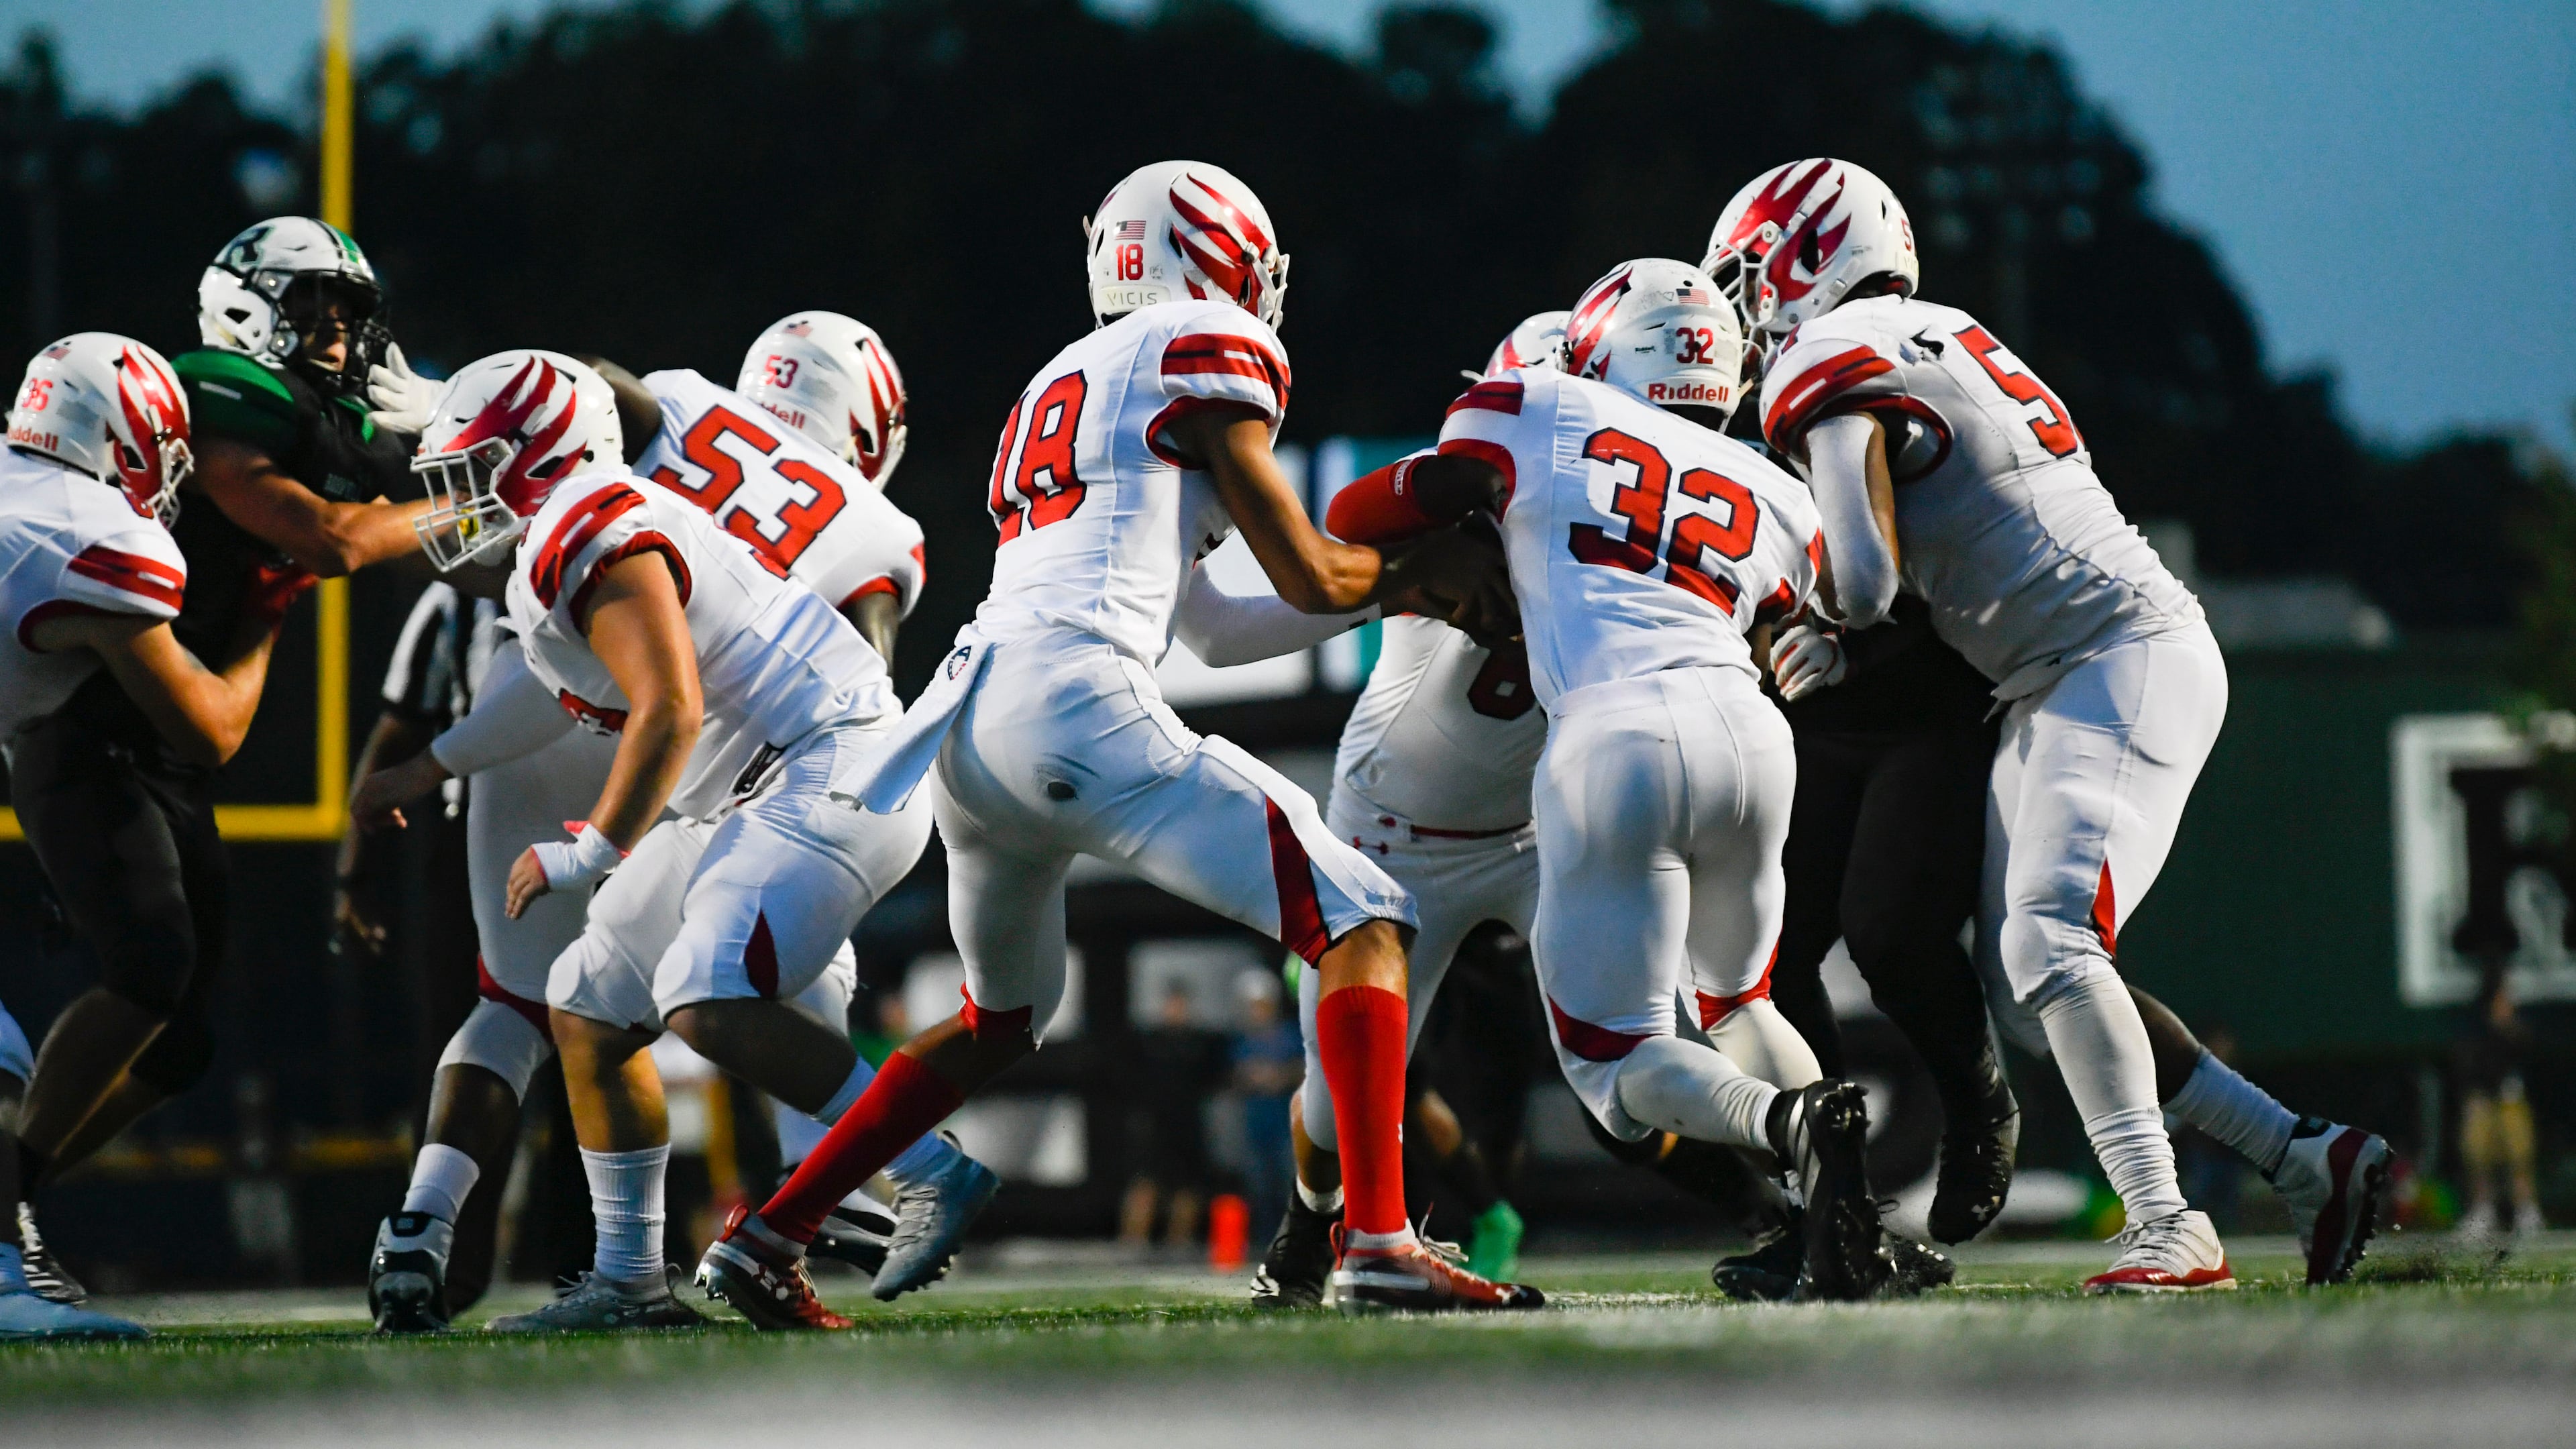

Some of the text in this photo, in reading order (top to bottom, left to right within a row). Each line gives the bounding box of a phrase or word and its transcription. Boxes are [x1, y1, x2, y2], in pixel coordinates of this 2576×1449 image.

[1116, 243, 1144, 280] 18
[1107, 292, 1158, 306] VICIS
[1676, 327, 1713, 364] 32
[764, 354, 799, 388] 53
[1648, 383, 1729, 402] Riddell
[1951, 324, 2088, 460] 5
[991, 368, 1088, 547] 18
[650, 404, 847, 582] 53
[1568, 427, 1760, 619] 32
